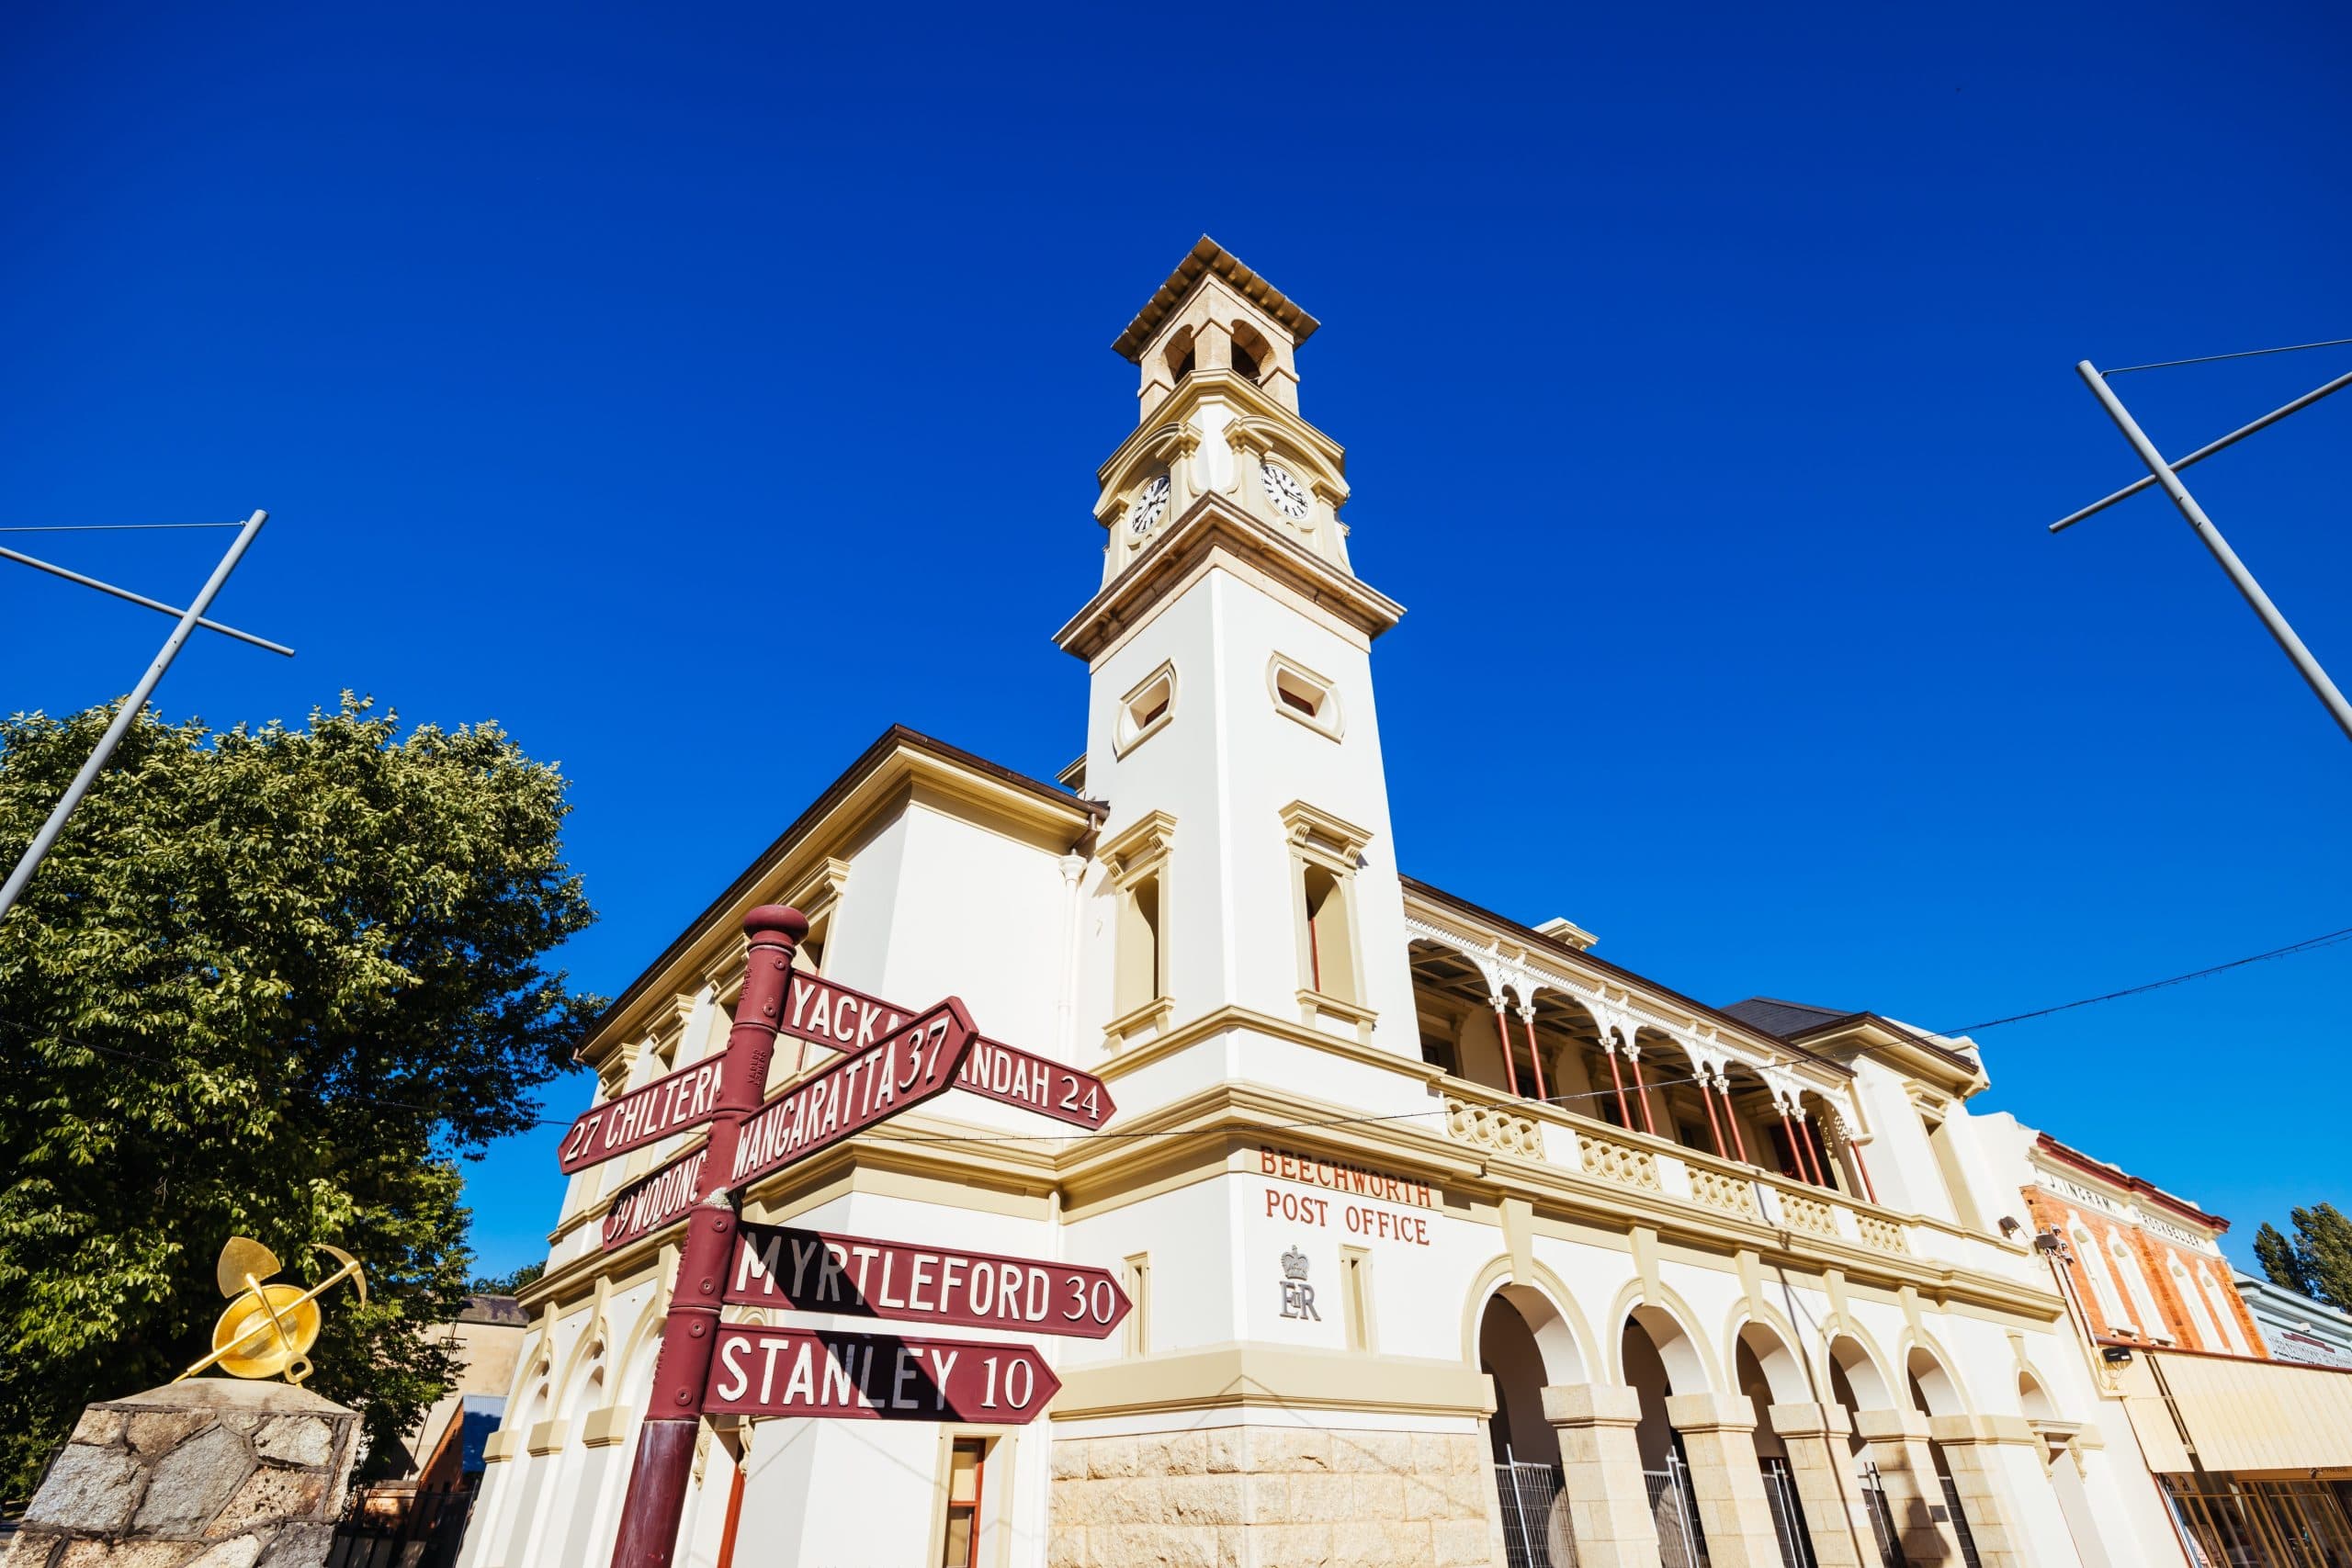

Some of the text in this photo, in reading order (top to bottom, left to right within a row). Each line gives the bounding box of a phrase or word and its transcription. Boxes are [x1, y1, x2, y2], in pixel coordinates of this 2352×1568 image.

[792, 978, 1049, 1107] YACKNDAH
[1058, 1076, 1100, 1119] 24
[564, 1114, 603, 1162] 27
[732, 1015, 950, 1181] WANGARATTA 37
[606, 1149, 707, 1240] 39 WODONG
[1261, 1145, 1431, 1207] BEECHWORTH
[1265, 1189, 1430, 1246] POST OFFICE
[735, 1232, 1115, 1324] MYRTLEFORD 30
[717, 1337, 1034, 1411] STANLEY 10
